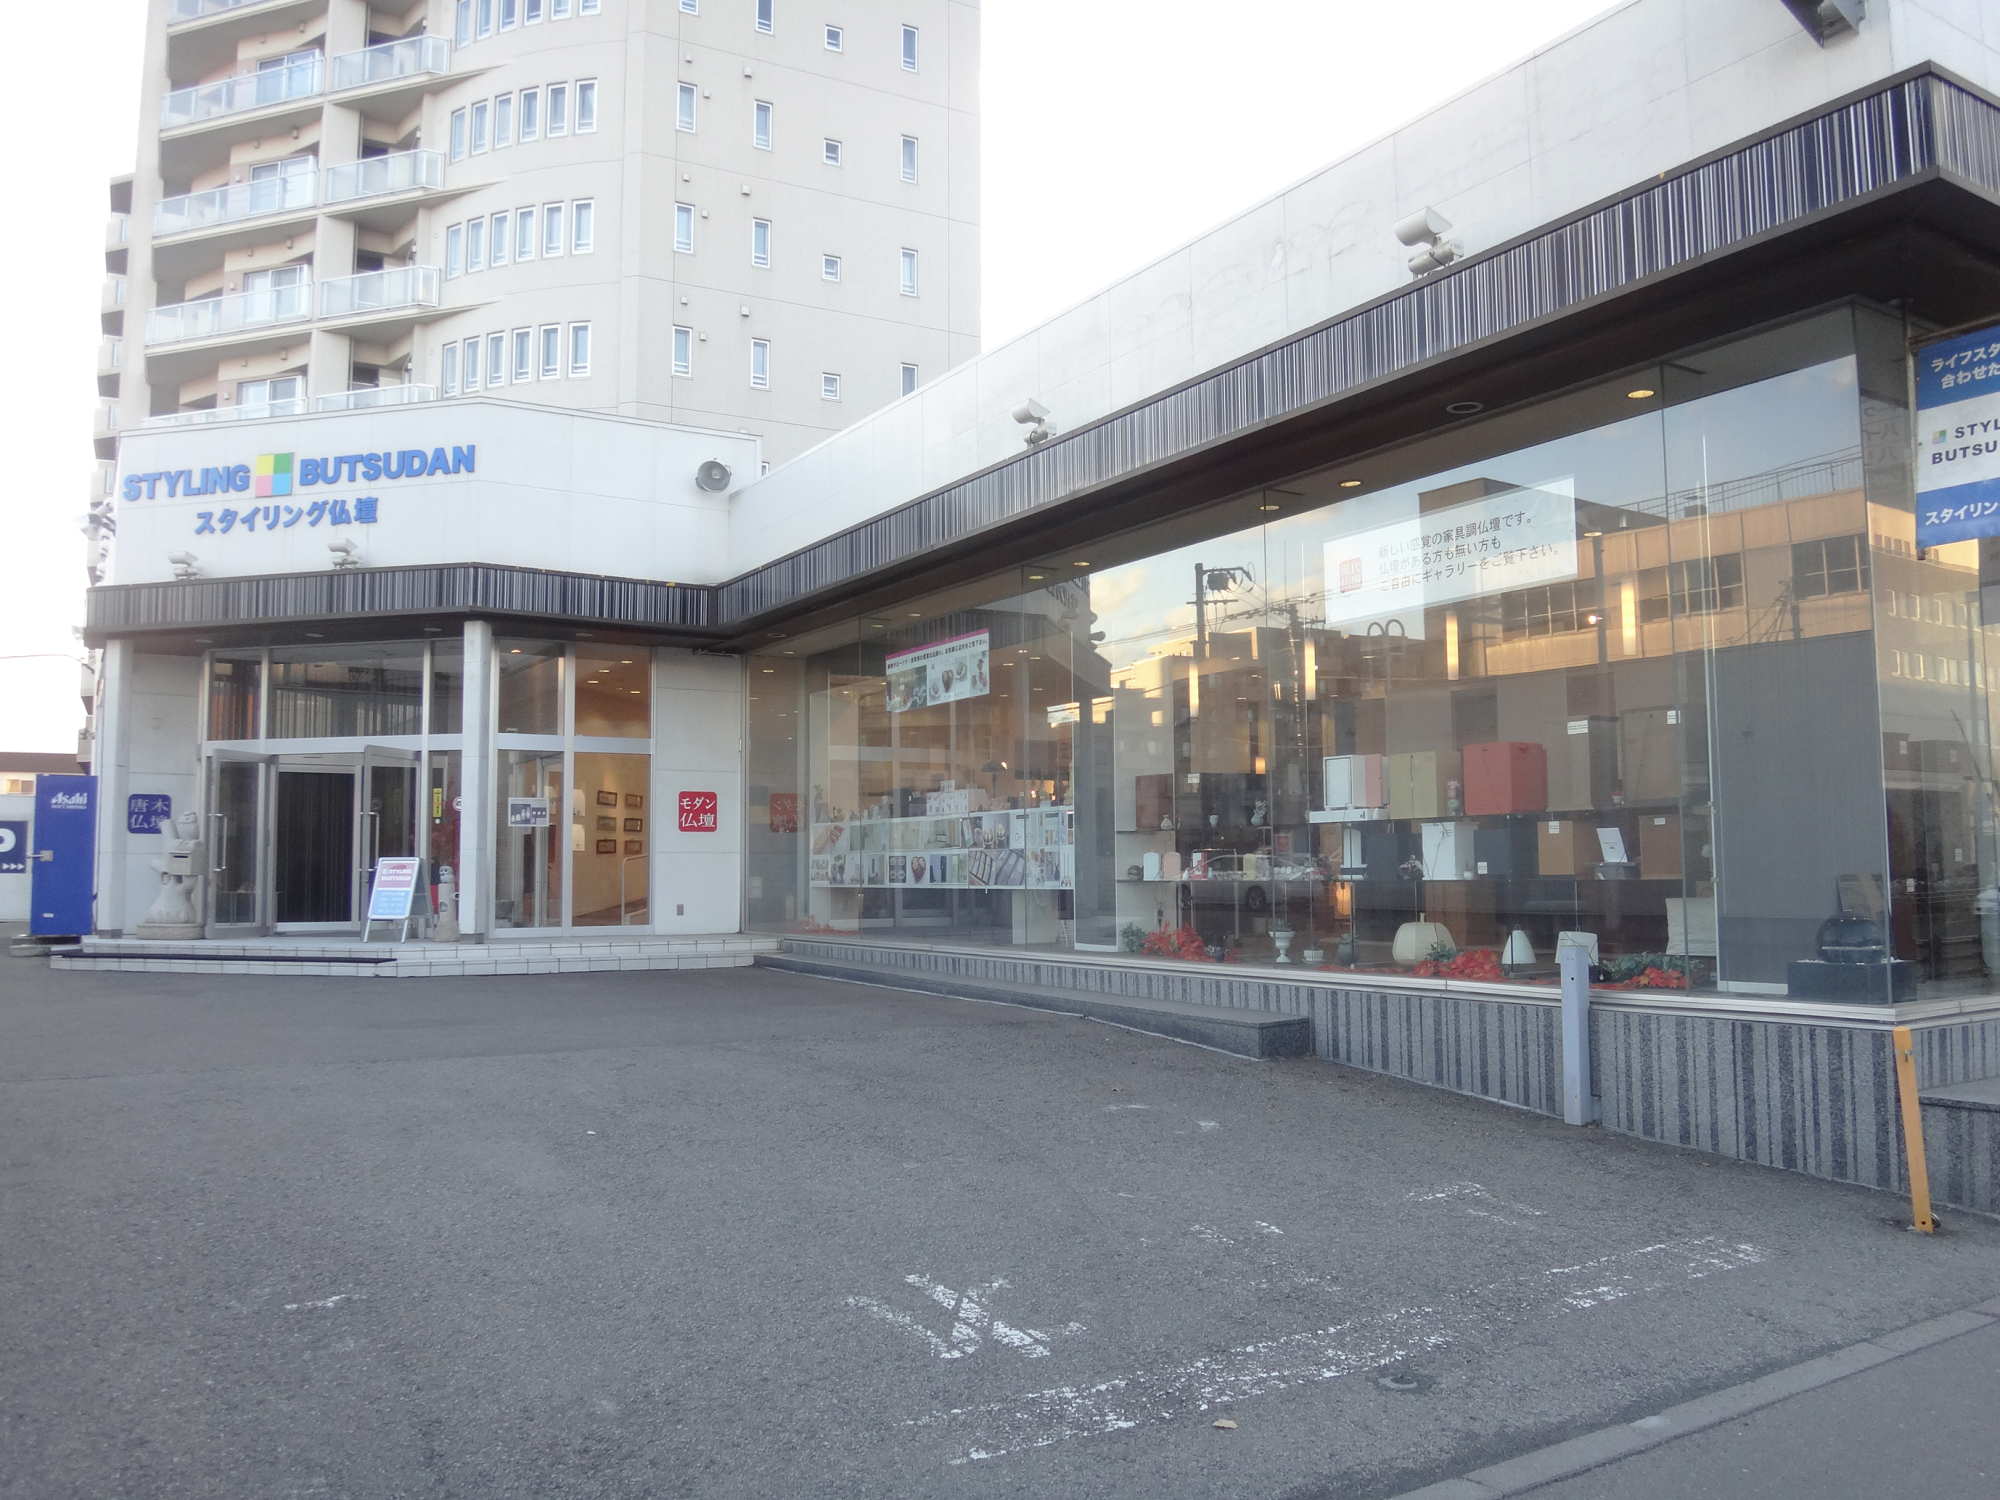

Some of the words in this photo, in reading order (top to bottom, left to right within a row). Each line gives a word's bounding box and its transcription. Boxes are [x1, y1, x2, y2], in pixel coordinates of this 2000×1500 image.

[1941, 362, 2000, 390] 合わせた
[1931, 440, 1998, 465] BUTSU
[123, 464, 251, 502] STYLING
[299, 444, 476, 486] BUTSUDAN
[194, 496, 379, 535] スタイリング仏壇
[50, 791, 88, 805] Asahi
[130, 798, 169, 813] 唐木
[680, 796, 716, 811] モダン
[680, 812, 716, 828] 仏壇
